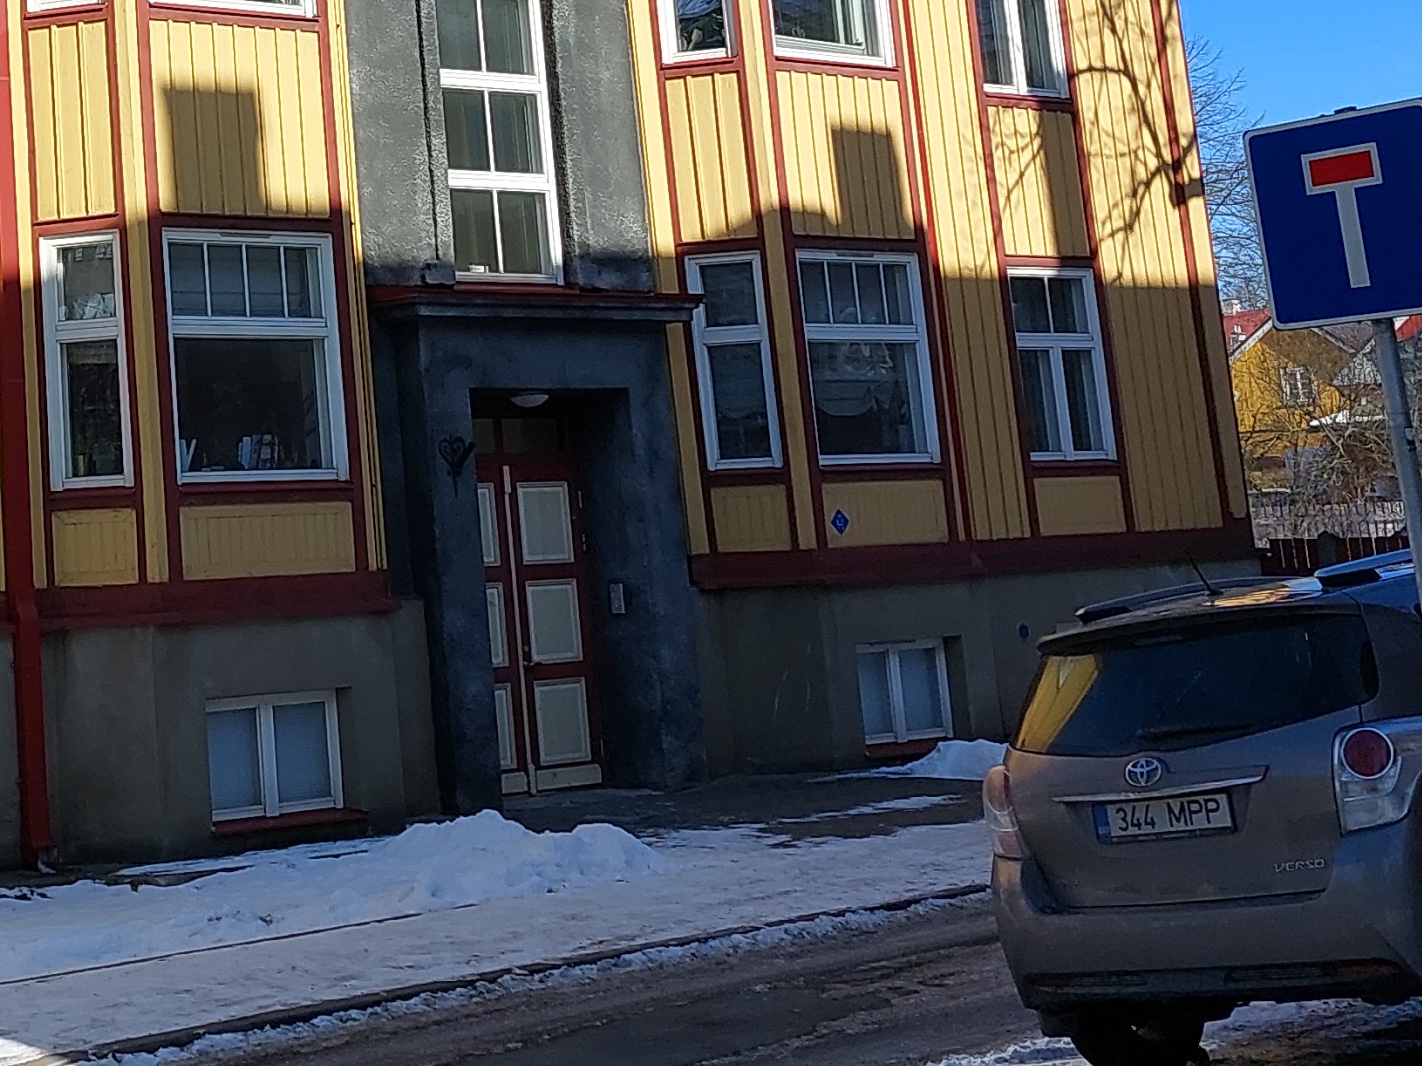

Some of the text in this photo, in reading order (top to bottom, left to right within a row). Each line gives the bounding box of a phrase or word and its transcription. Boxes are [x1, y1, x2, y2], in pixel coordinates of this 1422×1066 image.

[1115, 797, 1221, 831] 344 MPP
[1273, 858, 1325, 873] VERSO
